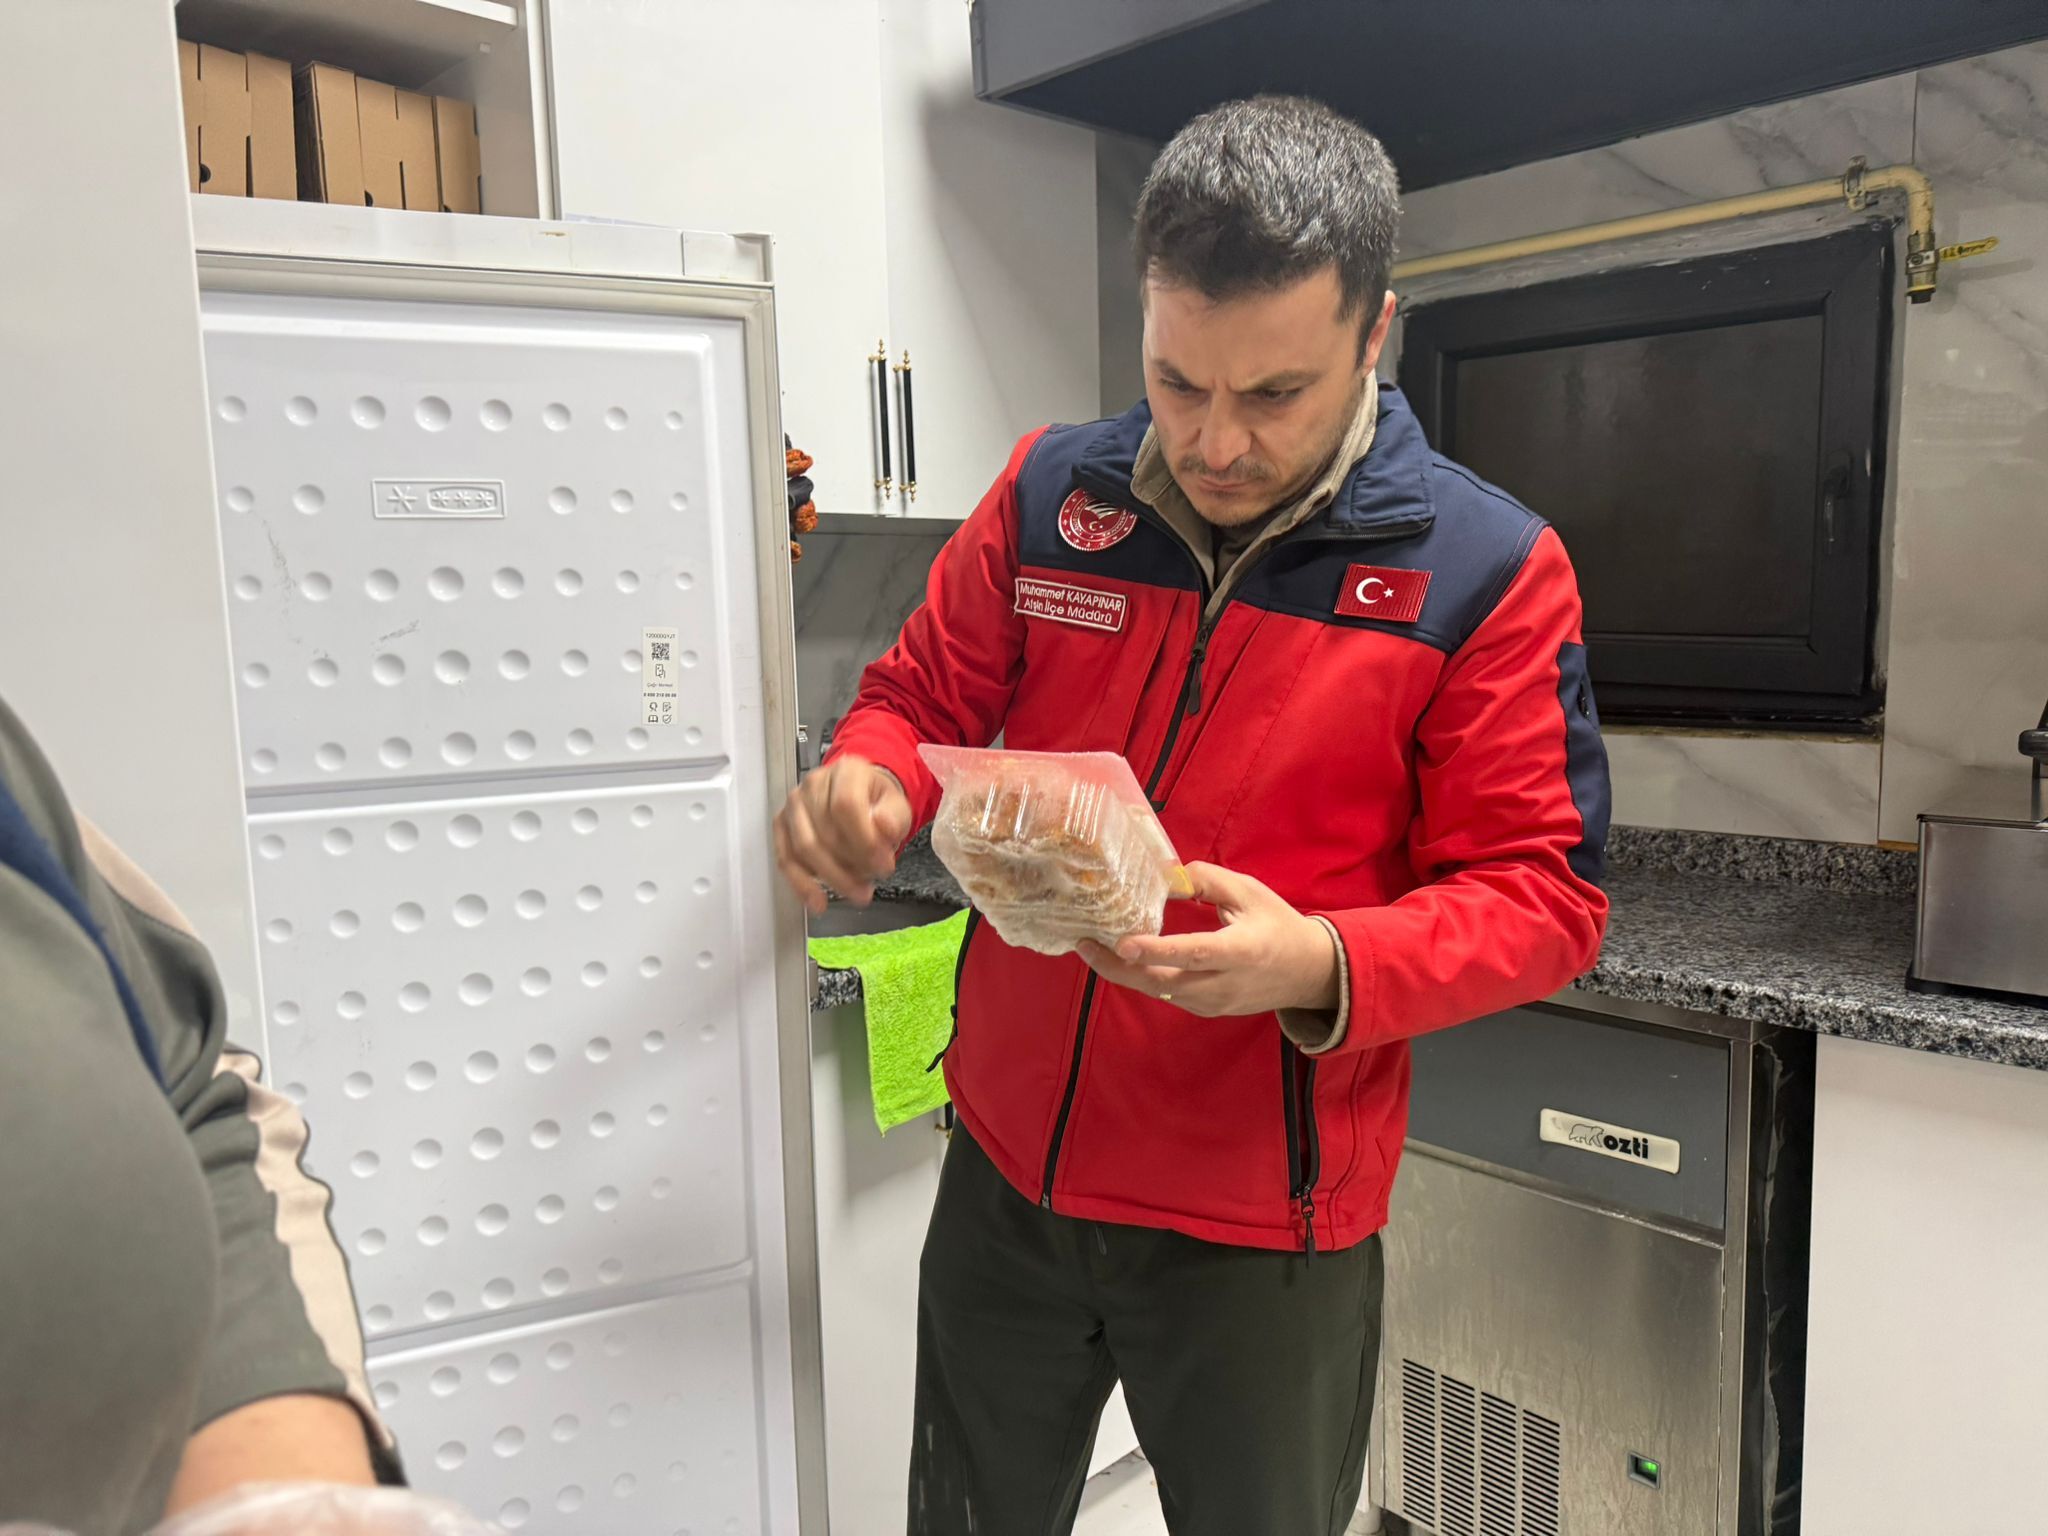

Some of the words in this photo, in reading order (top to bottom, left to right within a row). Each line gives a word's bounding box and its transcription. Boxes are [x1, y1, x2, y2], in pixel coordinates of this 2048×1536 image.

[1020, 582, 1065, 600] Muhammet
[1066, 590, 1122, 612] KAYAPINAR
[1067, 605, 1112, 624] Müdürü
[1603, 1135, 1648, 1159] ozti
